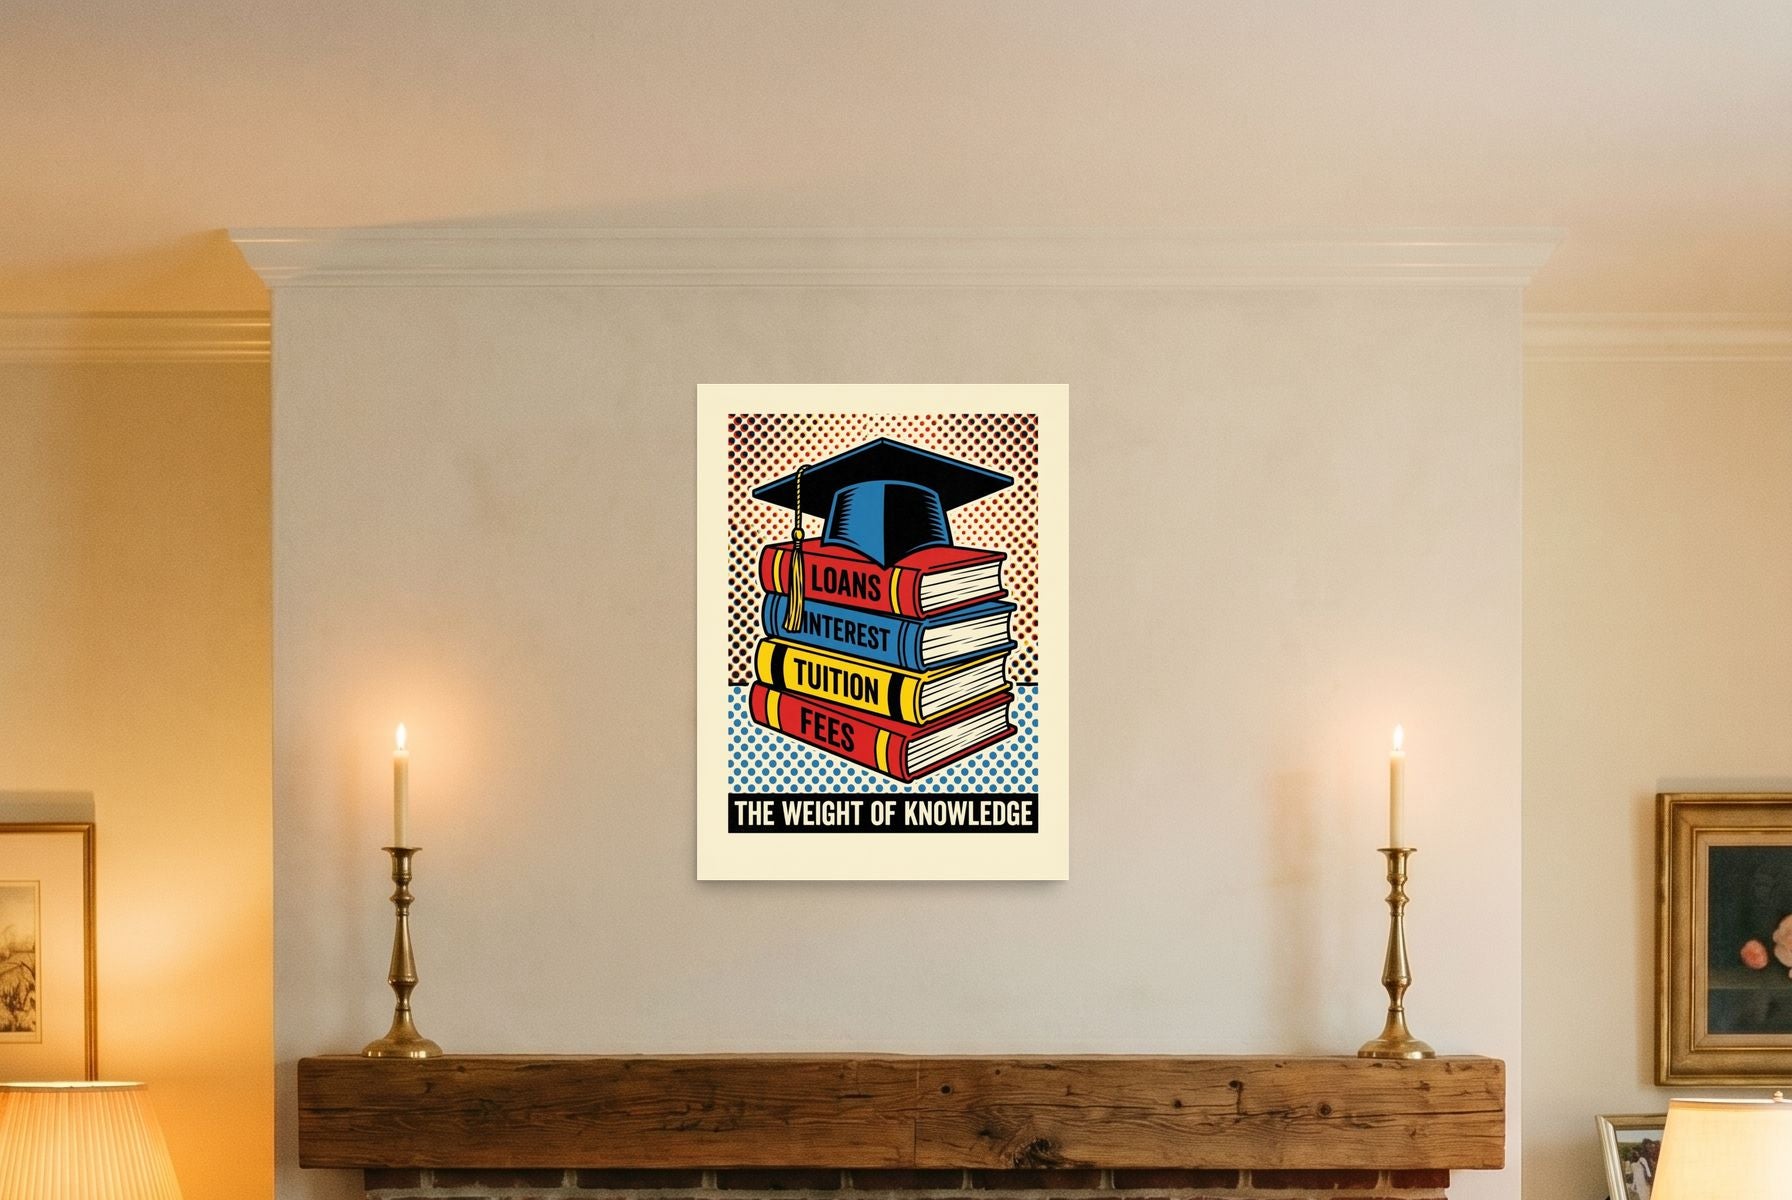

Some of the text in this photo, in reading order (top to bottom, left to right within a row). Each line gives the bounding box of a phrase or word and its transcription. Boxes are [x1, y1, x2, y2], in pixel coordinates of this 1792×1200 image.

[811, 564, 881, 602] LOANS
[802, 610, 891, 652] INTEREST
[793, 658, 879, 705] TUITION
[800, 706, 855, 753] FEES
[735, 800, 1033, 826] THE WEIGHT OF KNOWLEDGE
